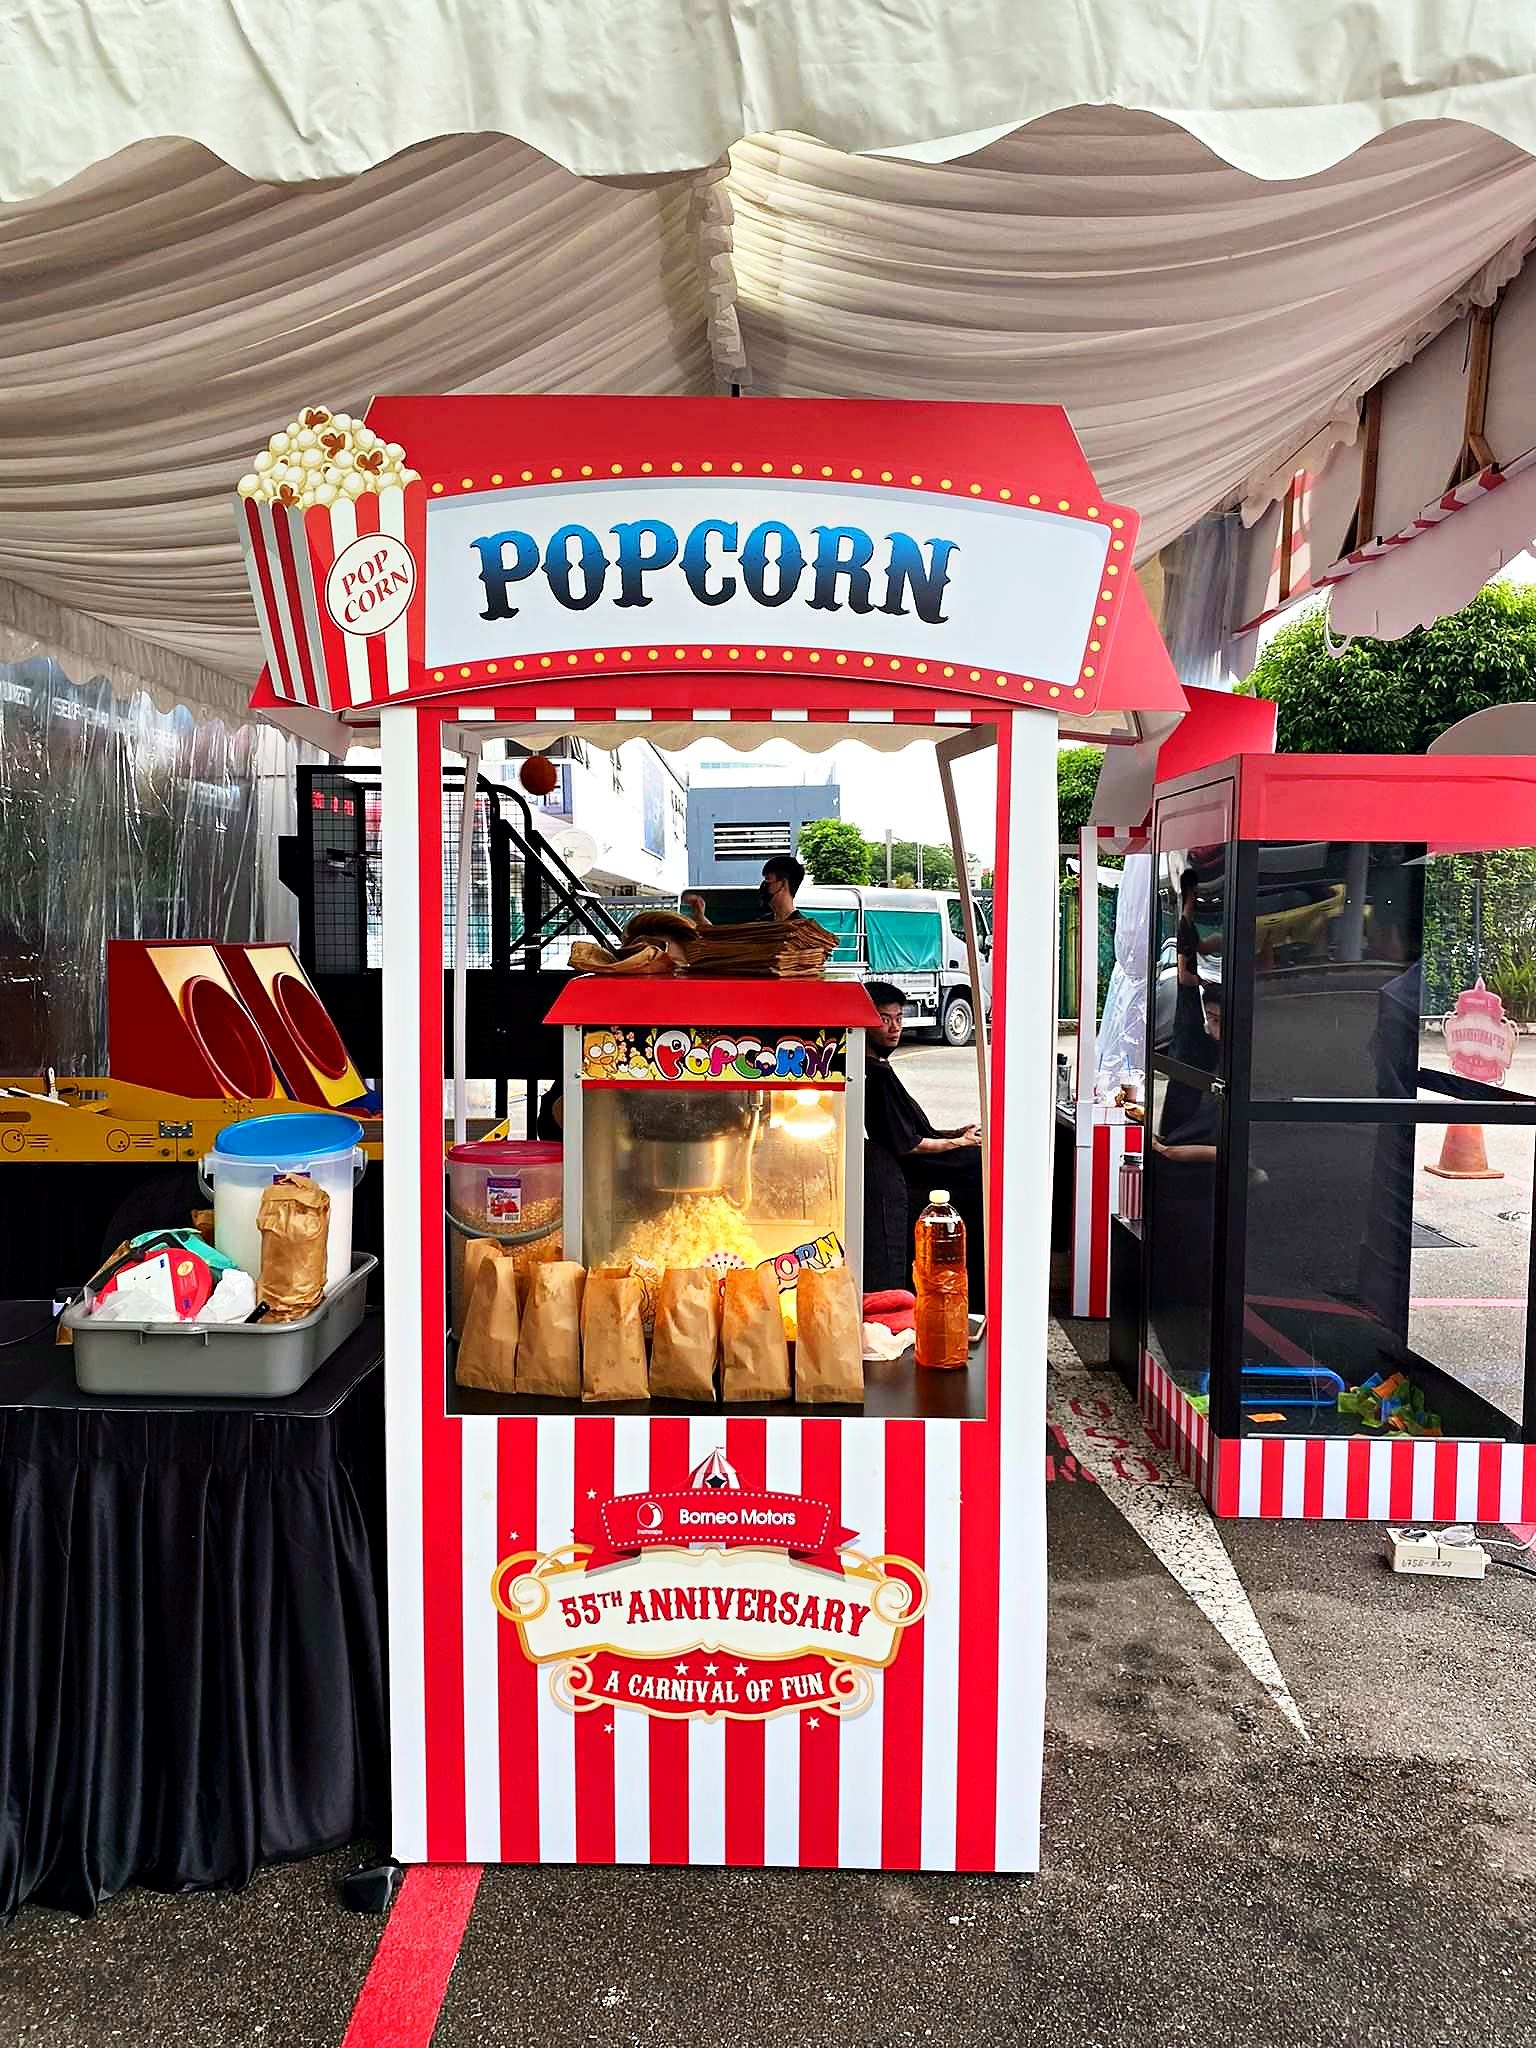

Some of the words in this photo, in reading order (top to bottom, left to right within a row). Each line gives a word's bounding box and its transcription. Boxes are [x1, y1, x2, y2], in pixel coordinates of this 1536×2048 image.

[341, 549, 388, 597] POP
[343, 563, 409, 623] CORN
[469, 518, 961, 625] POPCORN
[773, 1231, 845, 1281] ORN
[679, 1507, 738, 1526] Borneo
[740, 1507, 796, 1526] Motors
[558, 1588, 624, 1629] 55TH
[626, 1585, 872, 1637] ANNIVERSARY
[603, 1670, 620, 1693] A
[627, 1673, 740, 1704] CARNIVAL
[745, 1676, 773, 1703] OF
[780, 1670, 825, 1698] FUN
